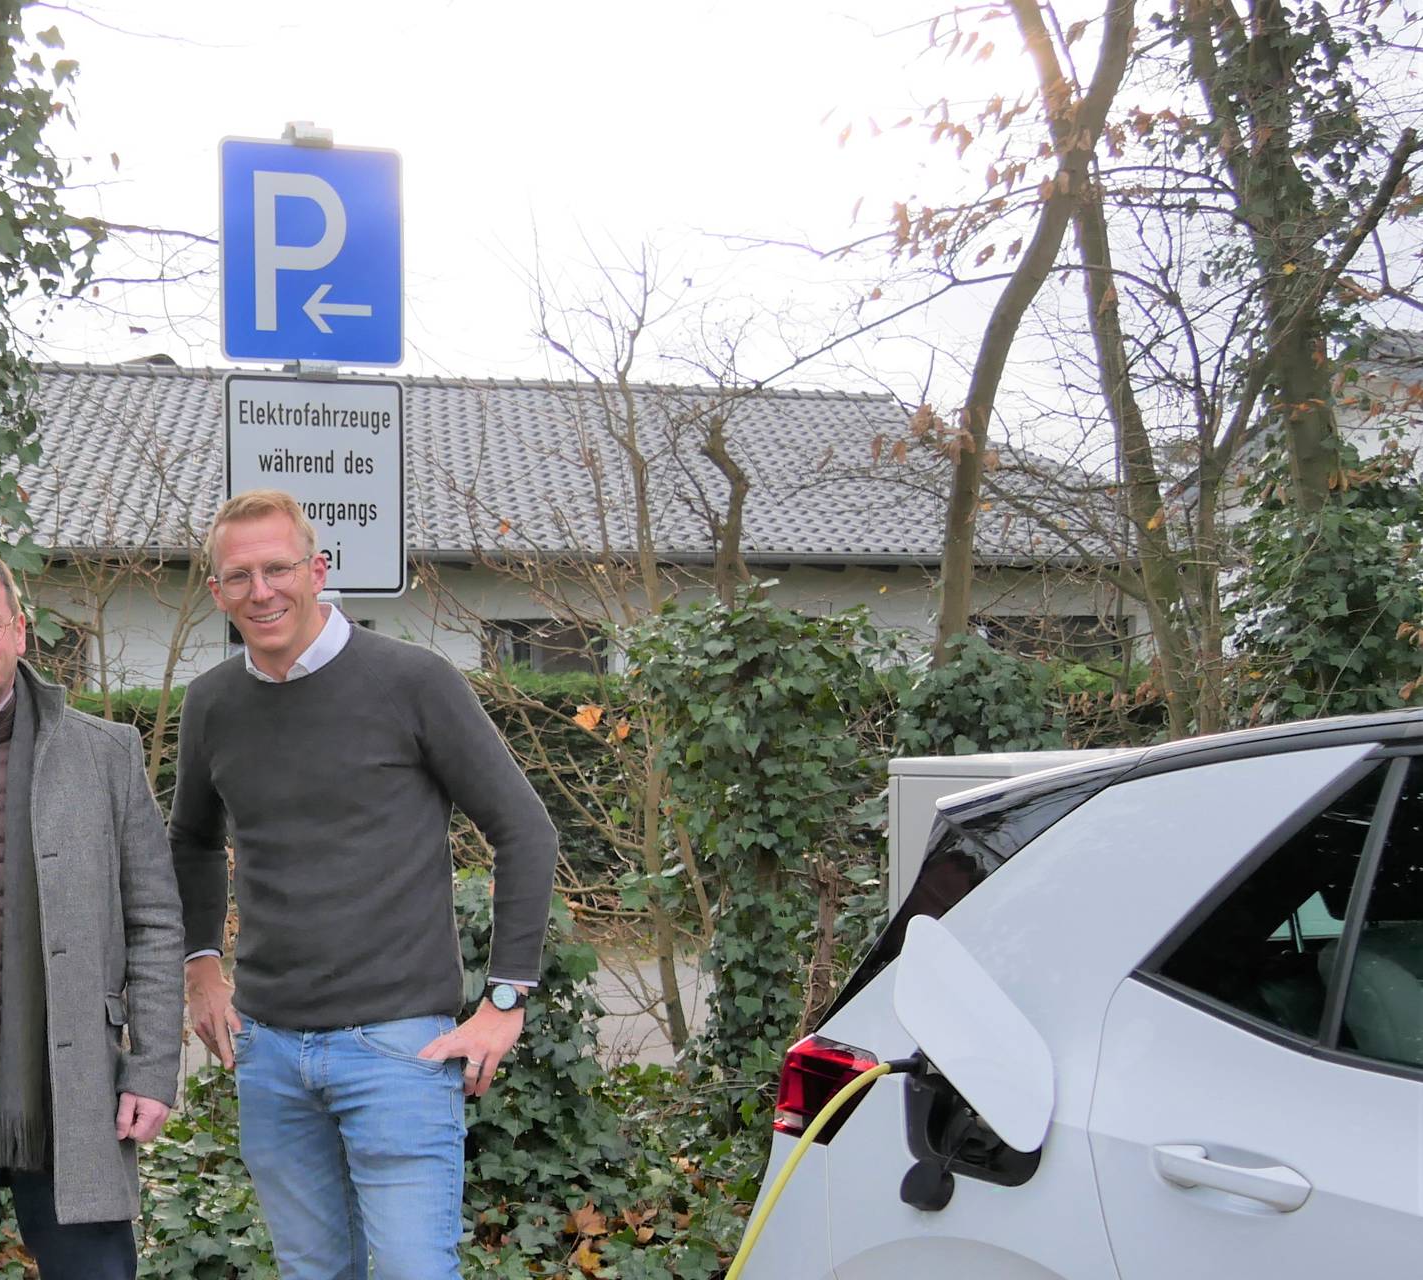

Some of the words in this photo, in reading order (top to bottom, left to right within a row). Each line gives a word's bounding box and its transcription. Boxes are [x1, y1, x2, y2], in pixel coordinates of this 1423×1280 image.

[253, 170, 347, 332] P
[238, 399, 392, 436] Elektrofahrzeuge
[257, 447, 335, 475] während
[344, 449, 375, 475] des
[319, 540, 342, 571] ei
